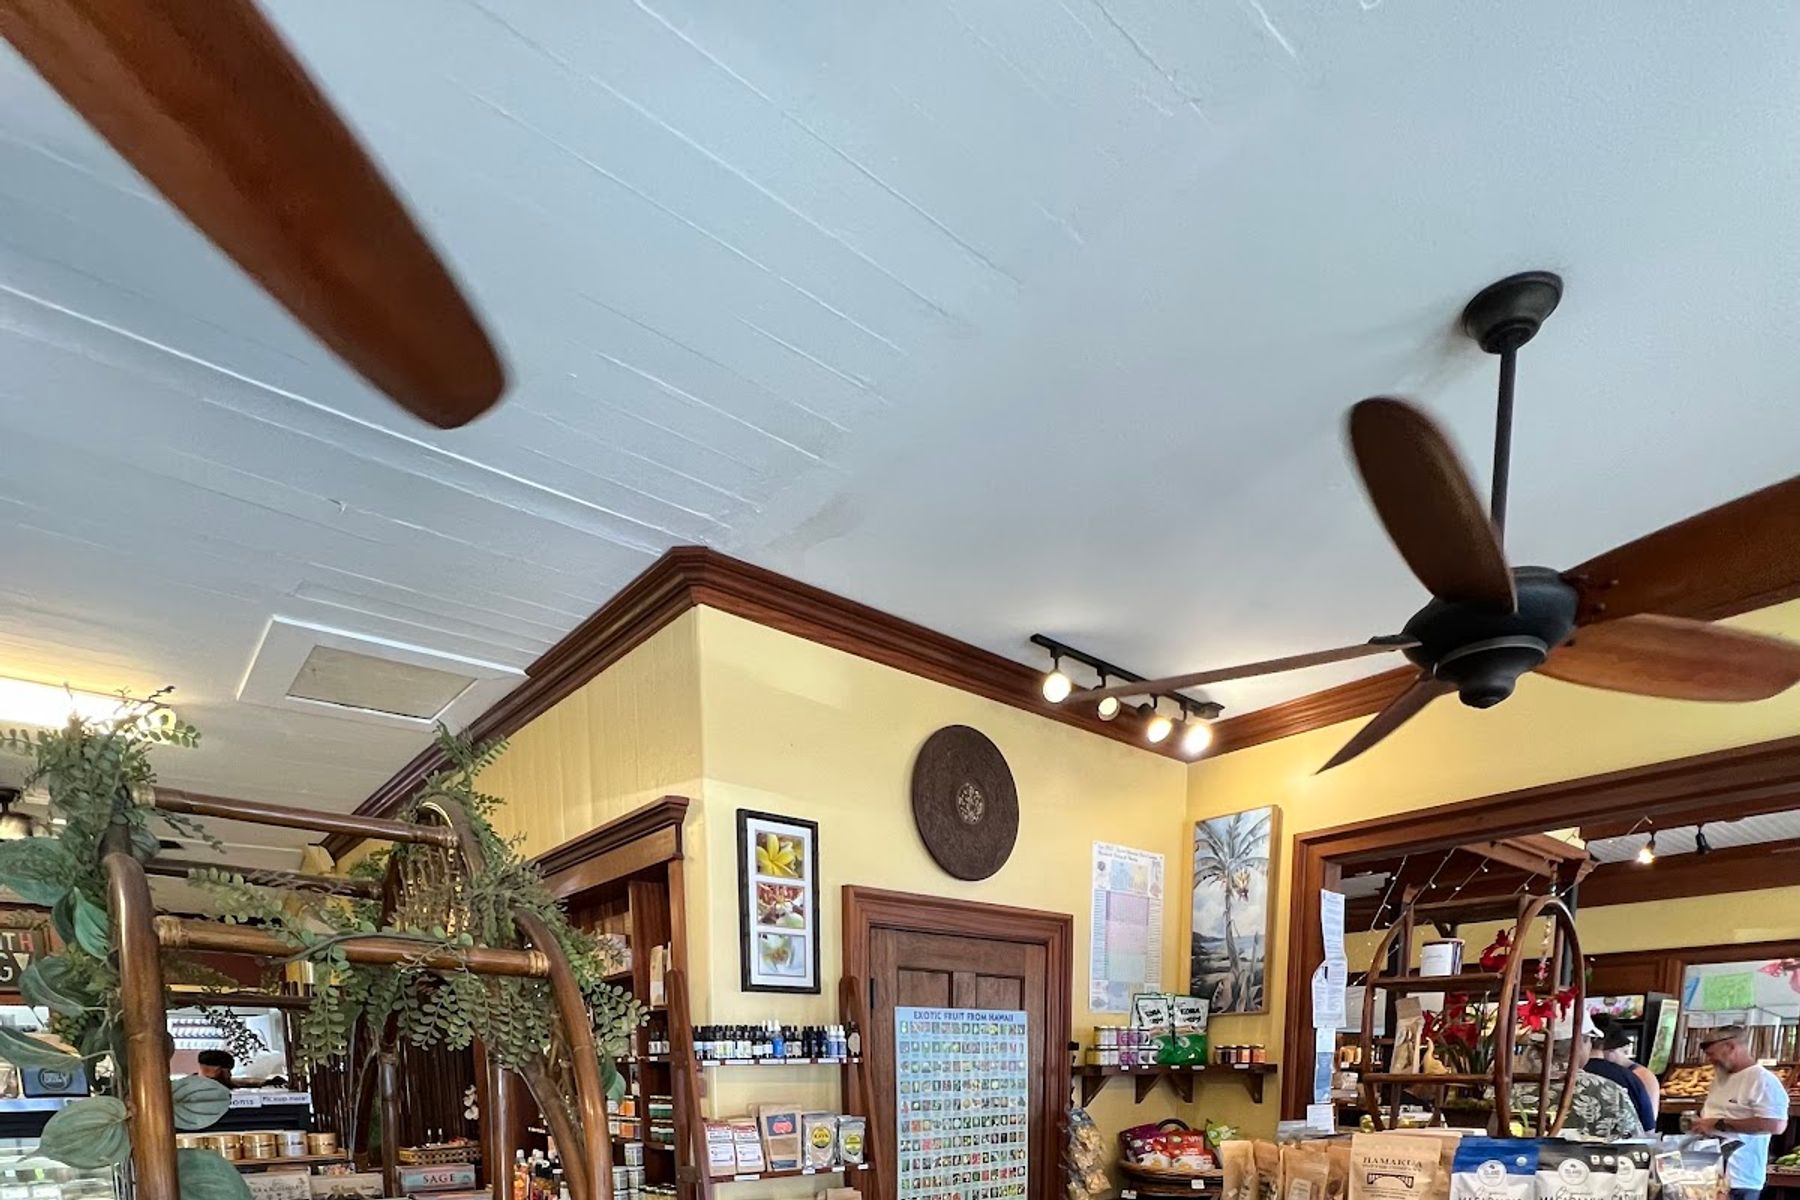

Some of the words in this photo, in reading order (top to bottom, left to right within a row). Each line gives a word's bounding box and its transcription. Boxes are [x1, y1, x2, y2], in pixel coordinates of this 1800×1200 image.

[914, 1011, 941, 1020] EXOTIC
[943, 1011, 965, 1020] FRUIT
[967, 1013, 987, 1021] FROM
[1363, 1157, 1422, 1168] HAMAKUA
[423, 1174, 455, 1184] SAGE
